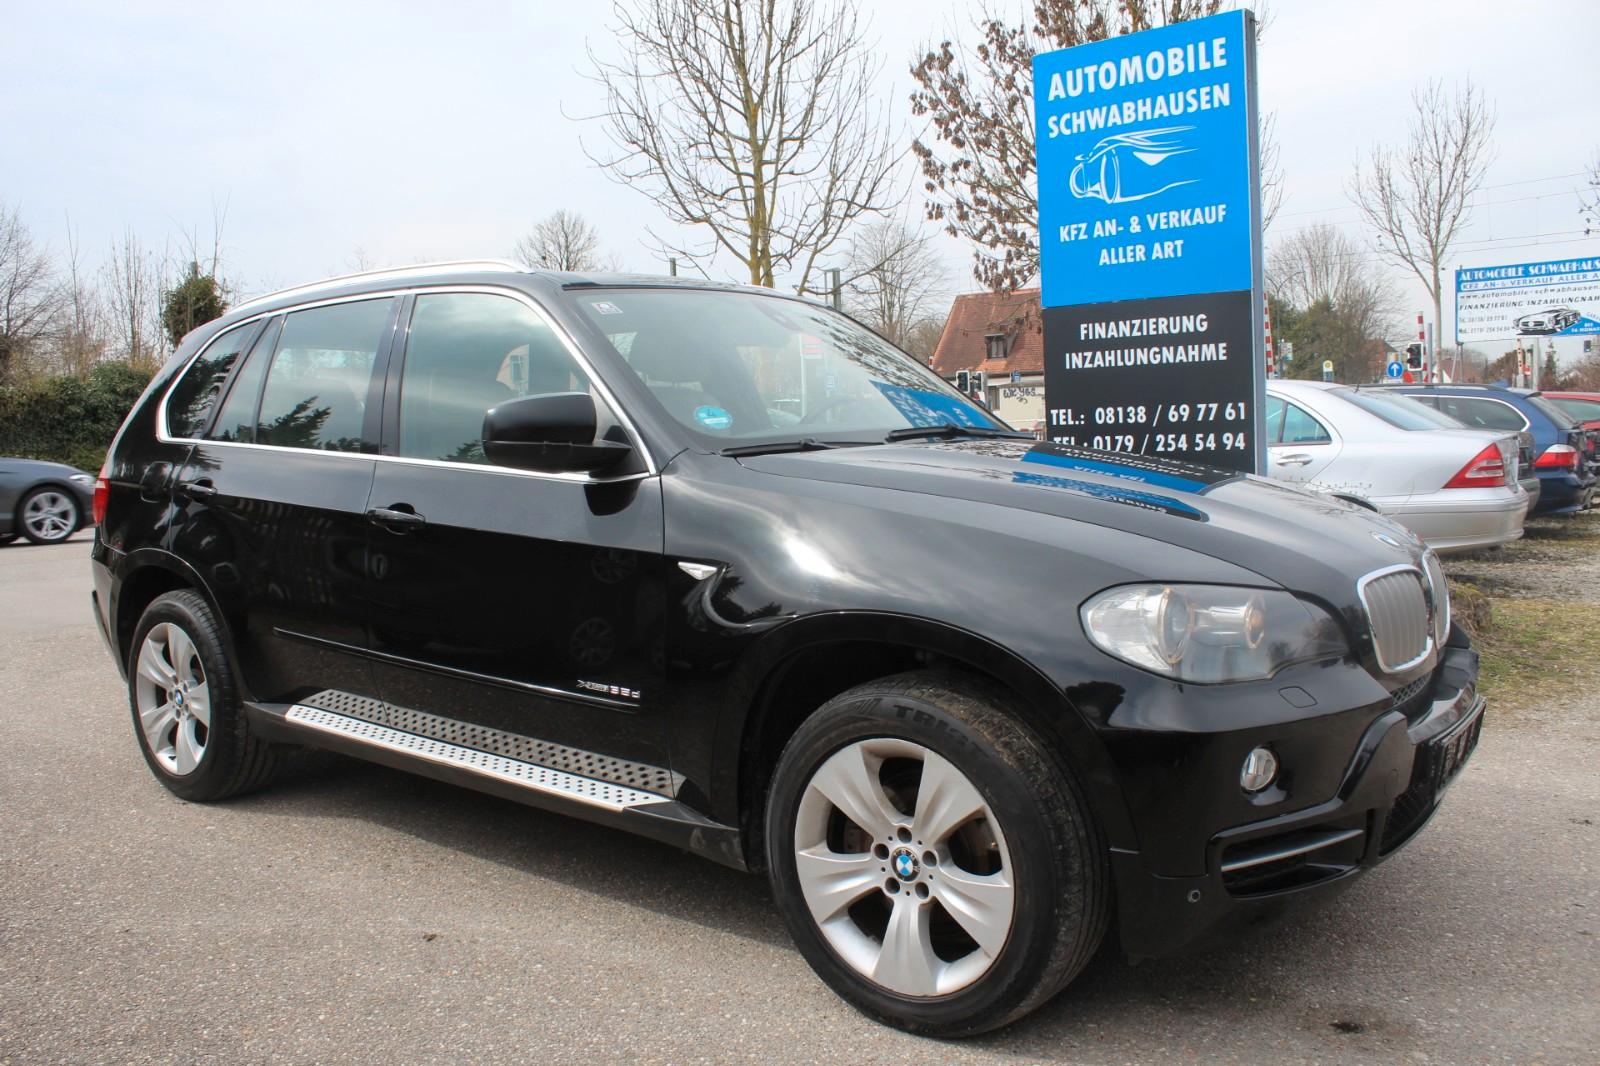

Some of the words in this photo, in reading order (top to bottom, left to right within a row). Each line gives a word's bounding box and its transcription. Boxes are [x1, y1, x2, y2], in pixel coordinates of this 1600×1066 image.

[1048, 37, 1227, 101] AUTOMOBILE
[1048, 83, 1230, 138] SCHWABHAUSEN
[1060, 224, 1088, 242] KFZ
[1094, 219, 1124, 238] AN-
[1129, 216, 1142, 234] &
[1147, 205, 1227, 231] VERKAUF
[1099, 244, 1146, 266] ALLER
[1152, 240, 1184, 260] ART
[1510, 276, 1553, 286] VERKAUF
[1559, 273, 1588, 282] ALLER
[1459, 300, 1524, 311] FINANZIERUNG
[1080, 313, 1209, 341] FINANZIERUNG
[1065, 342, 1228, 370] INZAHLUNGNAHME
[1050, 408, 1085, 426] TEL.:
[1095, 405, 1147, 425] 08138
[1152, 404, 1162, 427] /
[1168, 403, 1190, 423] 69
[1196, 402, 1219, 422] 77
[1224, 402, 1246, 421] 61
[1093, 434, 1135, 452] 0179
[1141, 433, 1150, 455] /
[1155, 433, 1189, 452] 254
[1194, 432, 1217, 452] 54
[1222, 432, 1246, 451] 94
